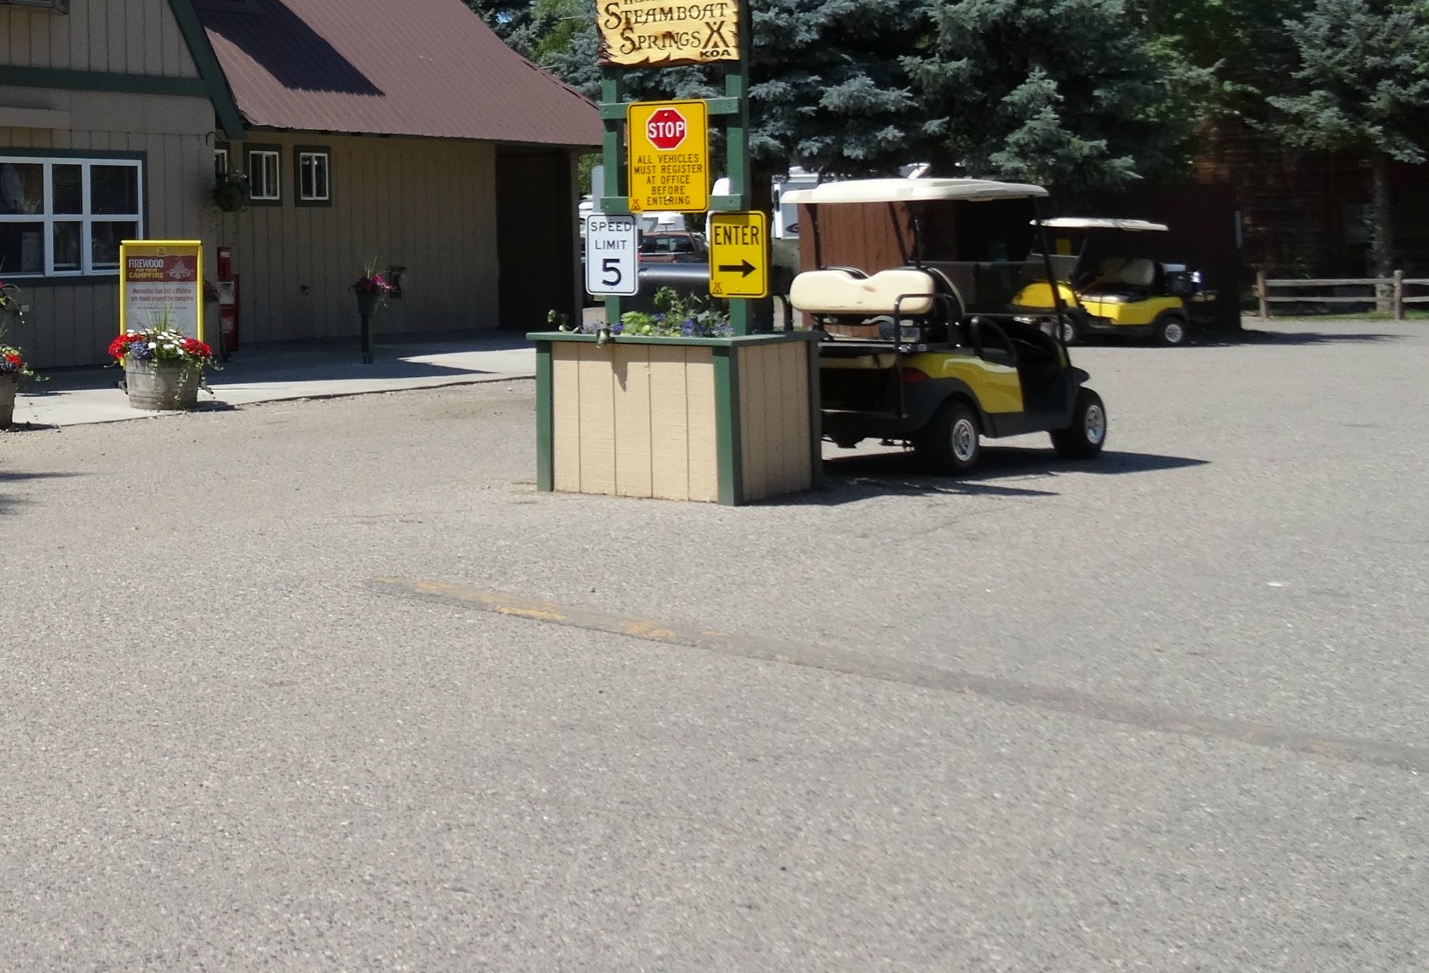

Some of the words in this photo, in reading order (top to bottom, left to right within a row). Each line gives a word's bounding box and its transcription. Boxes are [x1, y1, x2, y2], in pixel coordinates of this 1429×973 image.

[604, 2, 728, 30] STEAMBOAT
[620, 27, 701, 55] SPRINGS
[700, 49, 731, 58] KOA
[648, 121, 685, 139] STOP
[637, 155, 653, 164] ALL
[657, 154, 699, 163] VEHICLES
[634, 165, 656, 174] MUST
[661, 164, 703, 174] REGISTER
[646, 175, 656, 185] AT
[660, 175, 690, 184] OFFICE
[651, 185, 685, 195] BEFORE
[647, 196, 690, 205] ENTERING
[590, 221, 632, 232] SPEED
[714, 225, 759, 245] ENTER
[595, 240, 627, 250] LIMIT
[128, 259, 164, 268] FIREWOOD
[601, 258, 622, 287] 5
